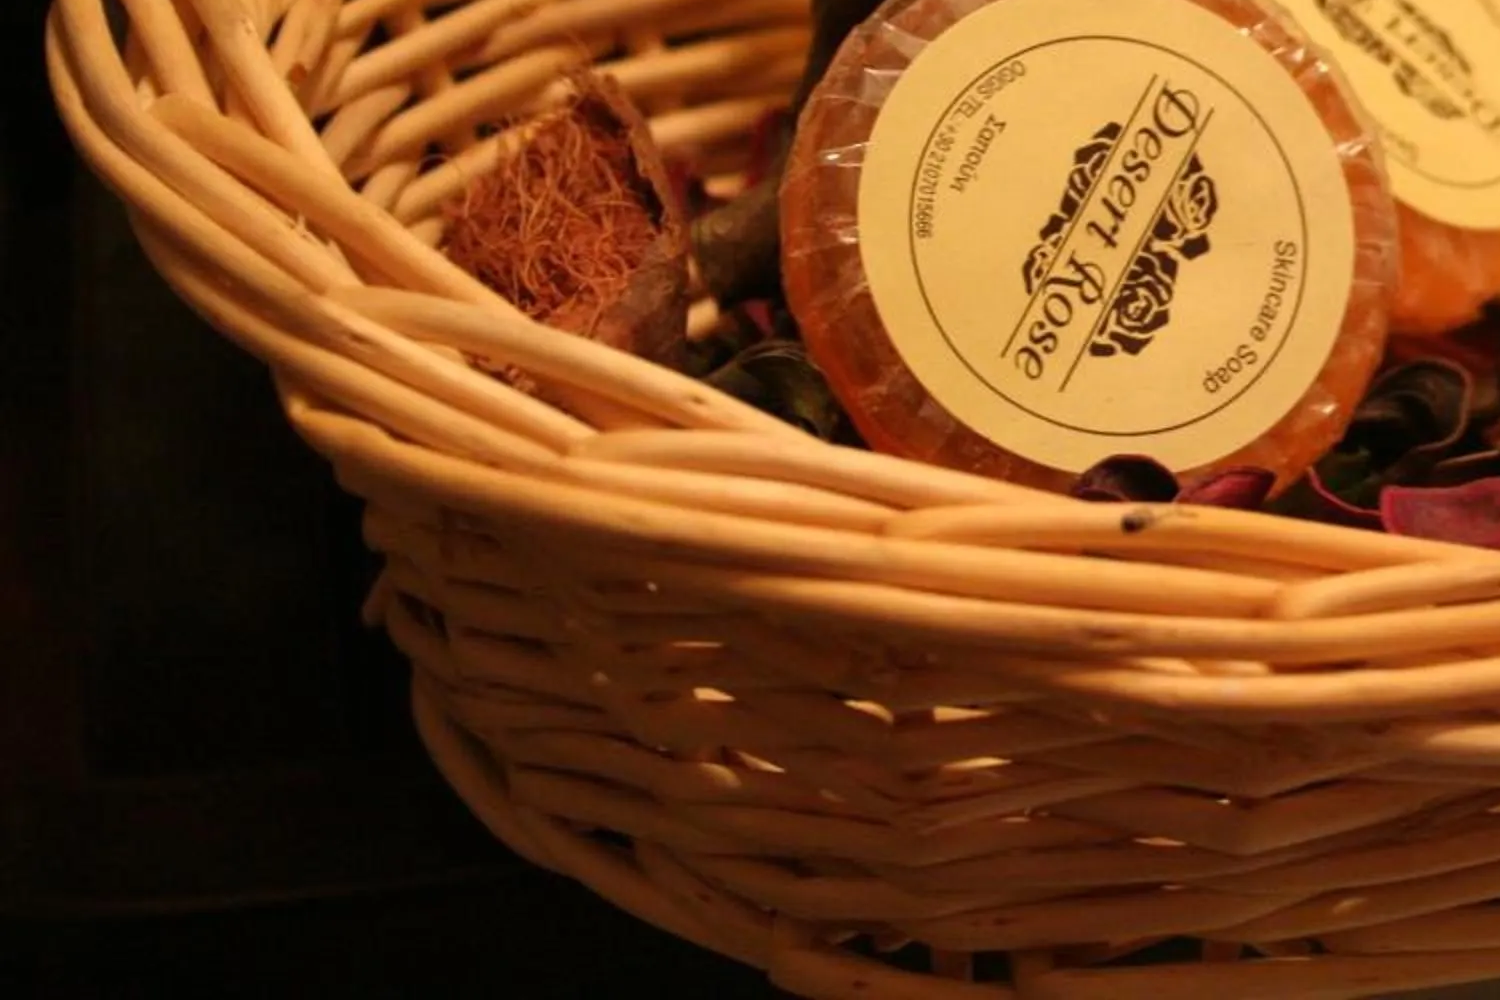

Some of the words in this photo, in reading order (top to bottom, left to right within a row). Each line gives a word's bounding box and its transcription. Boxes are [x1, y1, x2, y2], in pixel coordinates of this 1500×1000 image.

[949, 113, 1007, 193] Σαπούνι
[1086, 80, 1200, 249] Desert
[1014, 250, 1106, 380] Rose
[1250, 239, 1297, 342] Skincare
[1203, 344, 1259, 394] Soap
